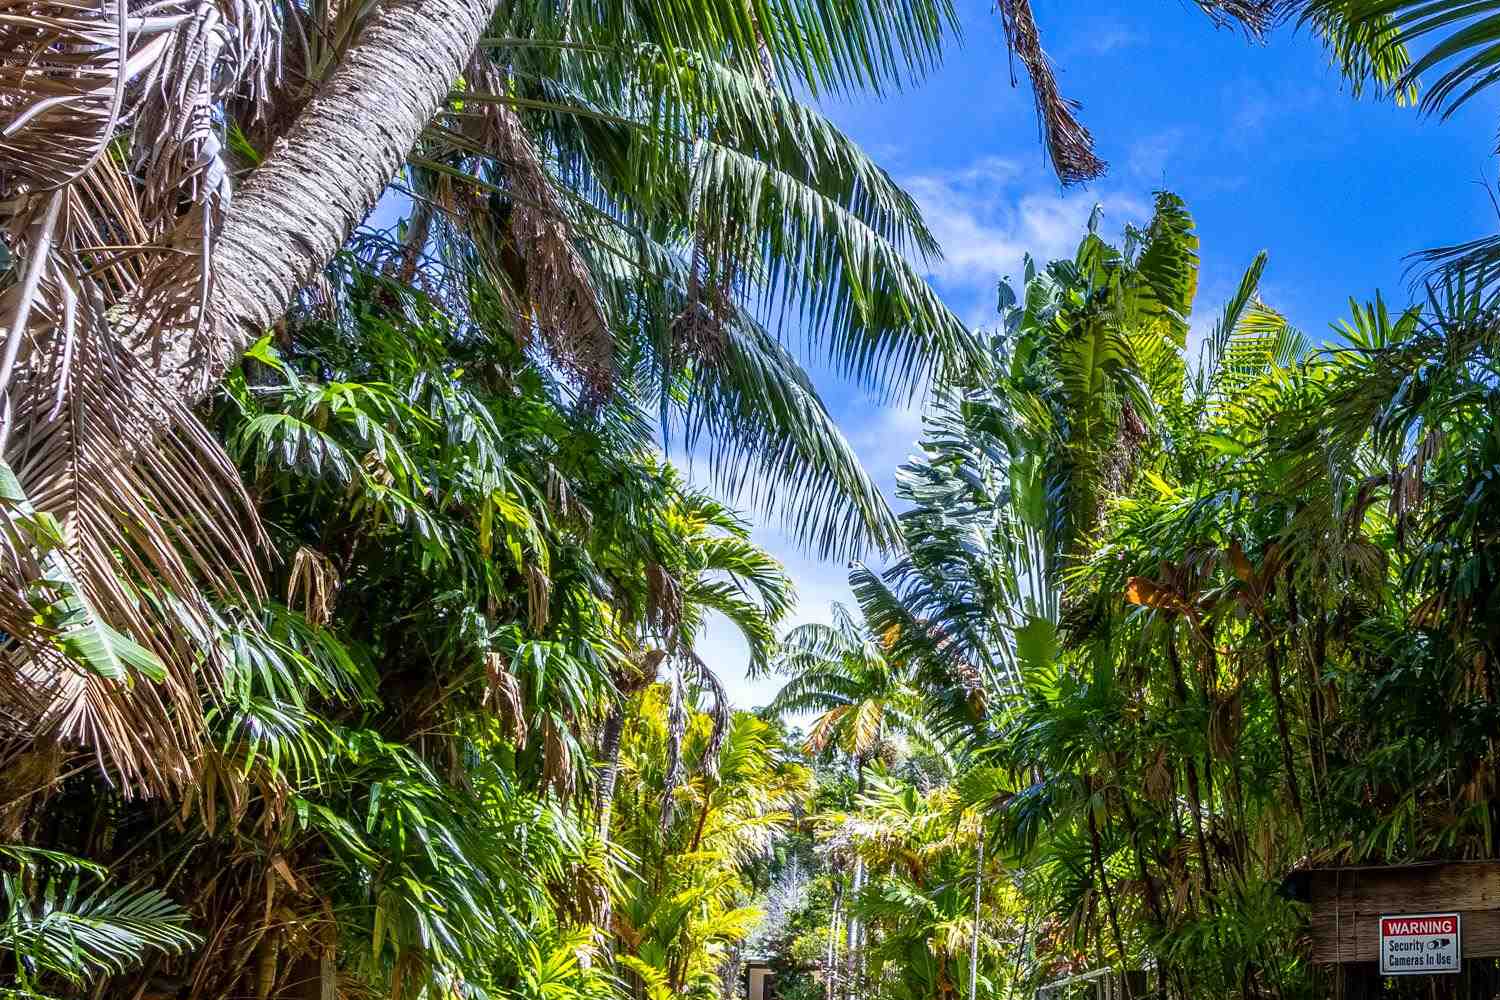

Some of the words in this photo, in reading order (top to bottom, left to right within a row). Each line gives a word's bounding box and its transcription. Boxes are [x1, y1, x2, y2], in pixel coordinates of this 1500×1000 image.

[1388, 921, 1453, 935] WARNING
[1389, 939, 1425, 954] Security
[1389, 955, 1425, 967] Cameras
[1426, 953, 1435, 966] In
[1436, 953, 1452, 965] Use
